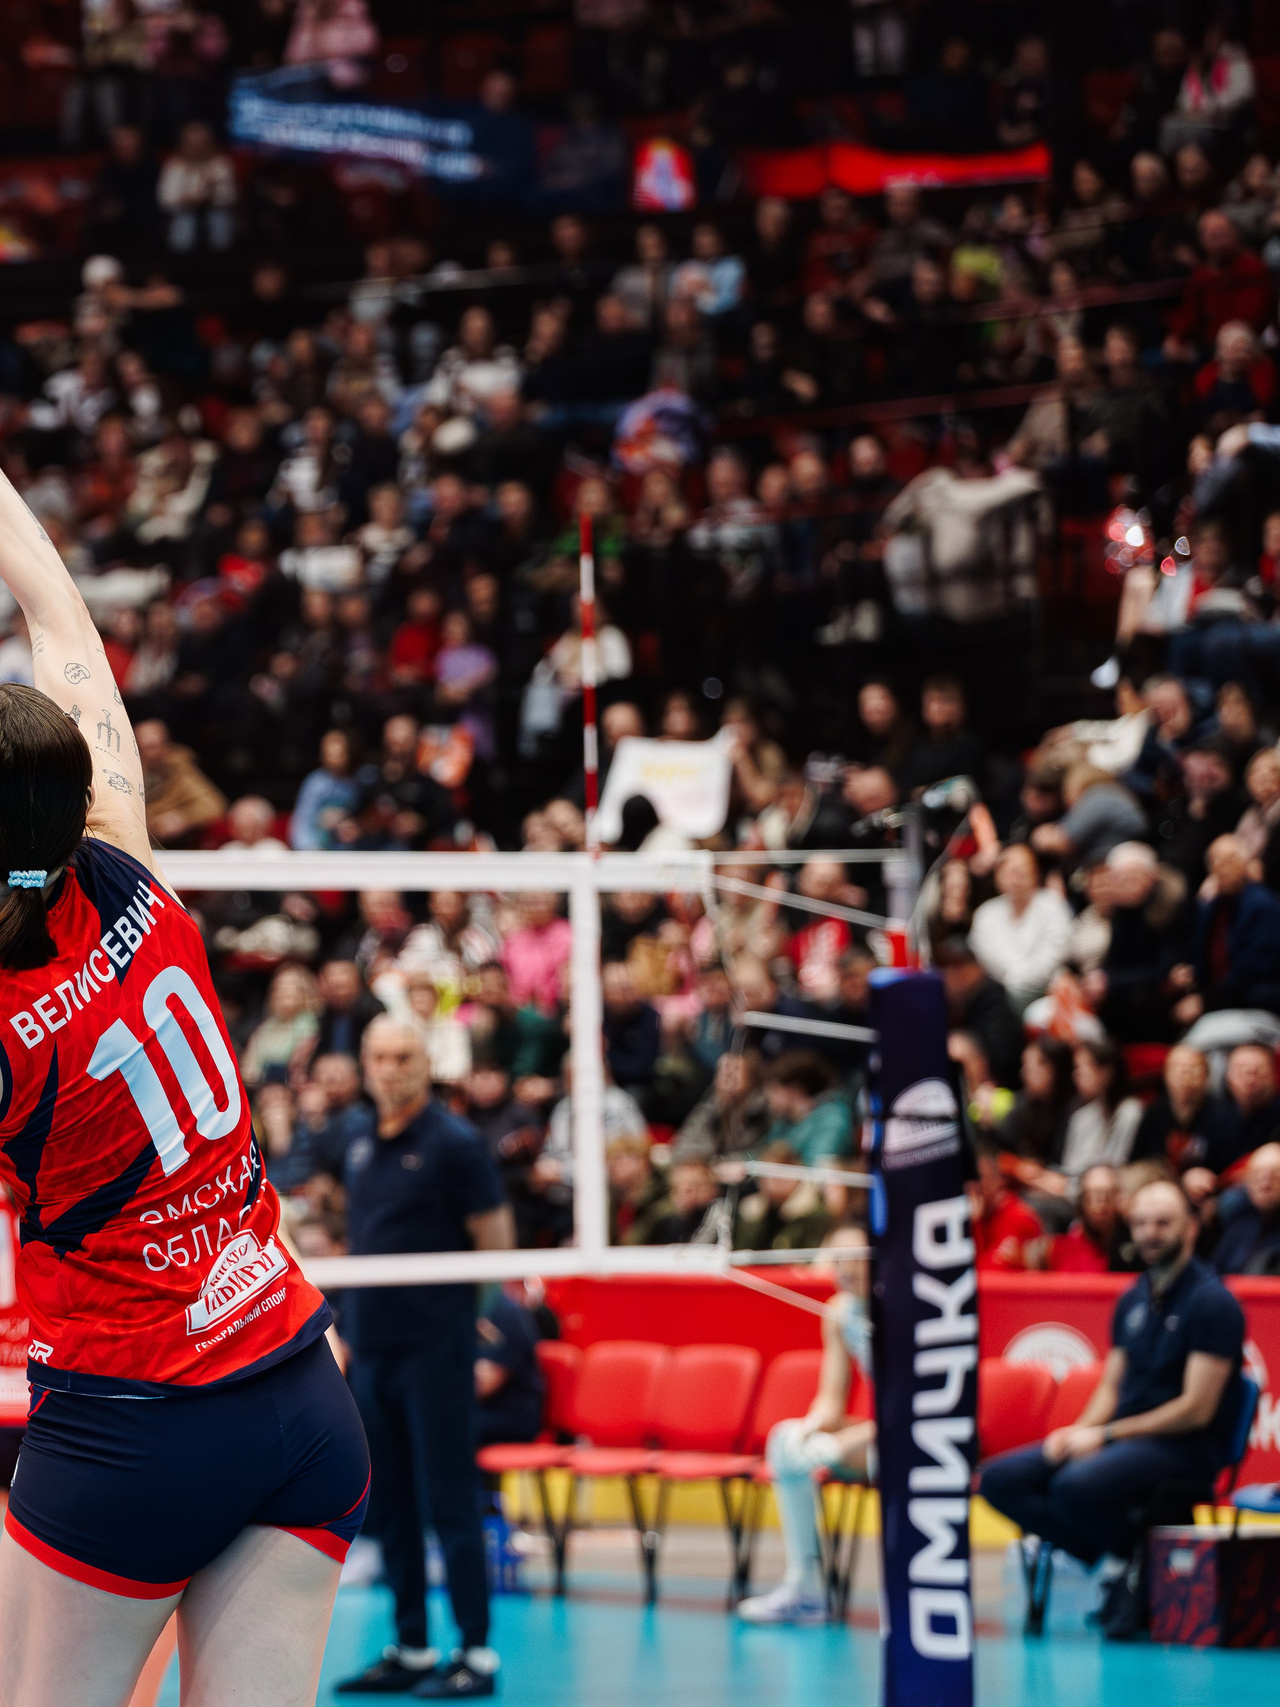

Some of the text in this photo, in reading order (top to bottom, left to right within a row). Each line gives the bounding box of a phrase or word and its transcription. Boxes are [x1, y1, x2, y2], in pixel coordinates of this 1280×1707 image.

[9, 880, 166, 1050] ВЕЛИСЕВИЧ
[86, 965, 241, 1177] 10
[907, 1194, 978, 1661] ОМИЧКА
